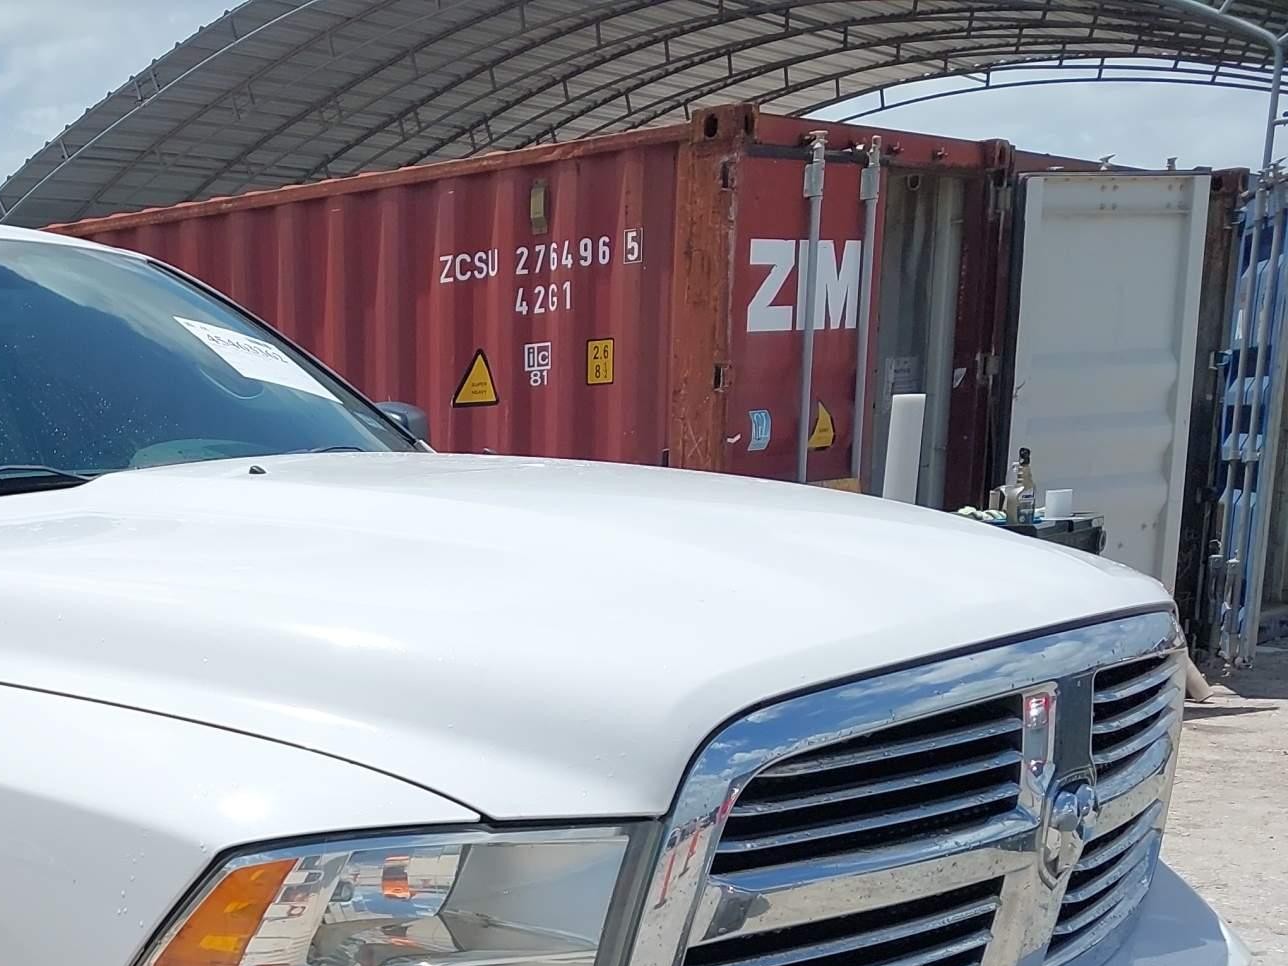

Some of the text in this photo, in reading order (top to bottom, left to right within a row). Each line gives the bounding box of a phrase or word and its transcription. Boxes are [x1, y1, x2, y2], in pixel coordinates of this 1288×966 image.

[439, 231, 640, 284] ZCSU 276496 5
[515, 281, 572, 315] 42G1
[746, 238, 862, 333] ZIM
[592, 344, 609, 360] 2.6
[529, 370, 548, 386] 81
